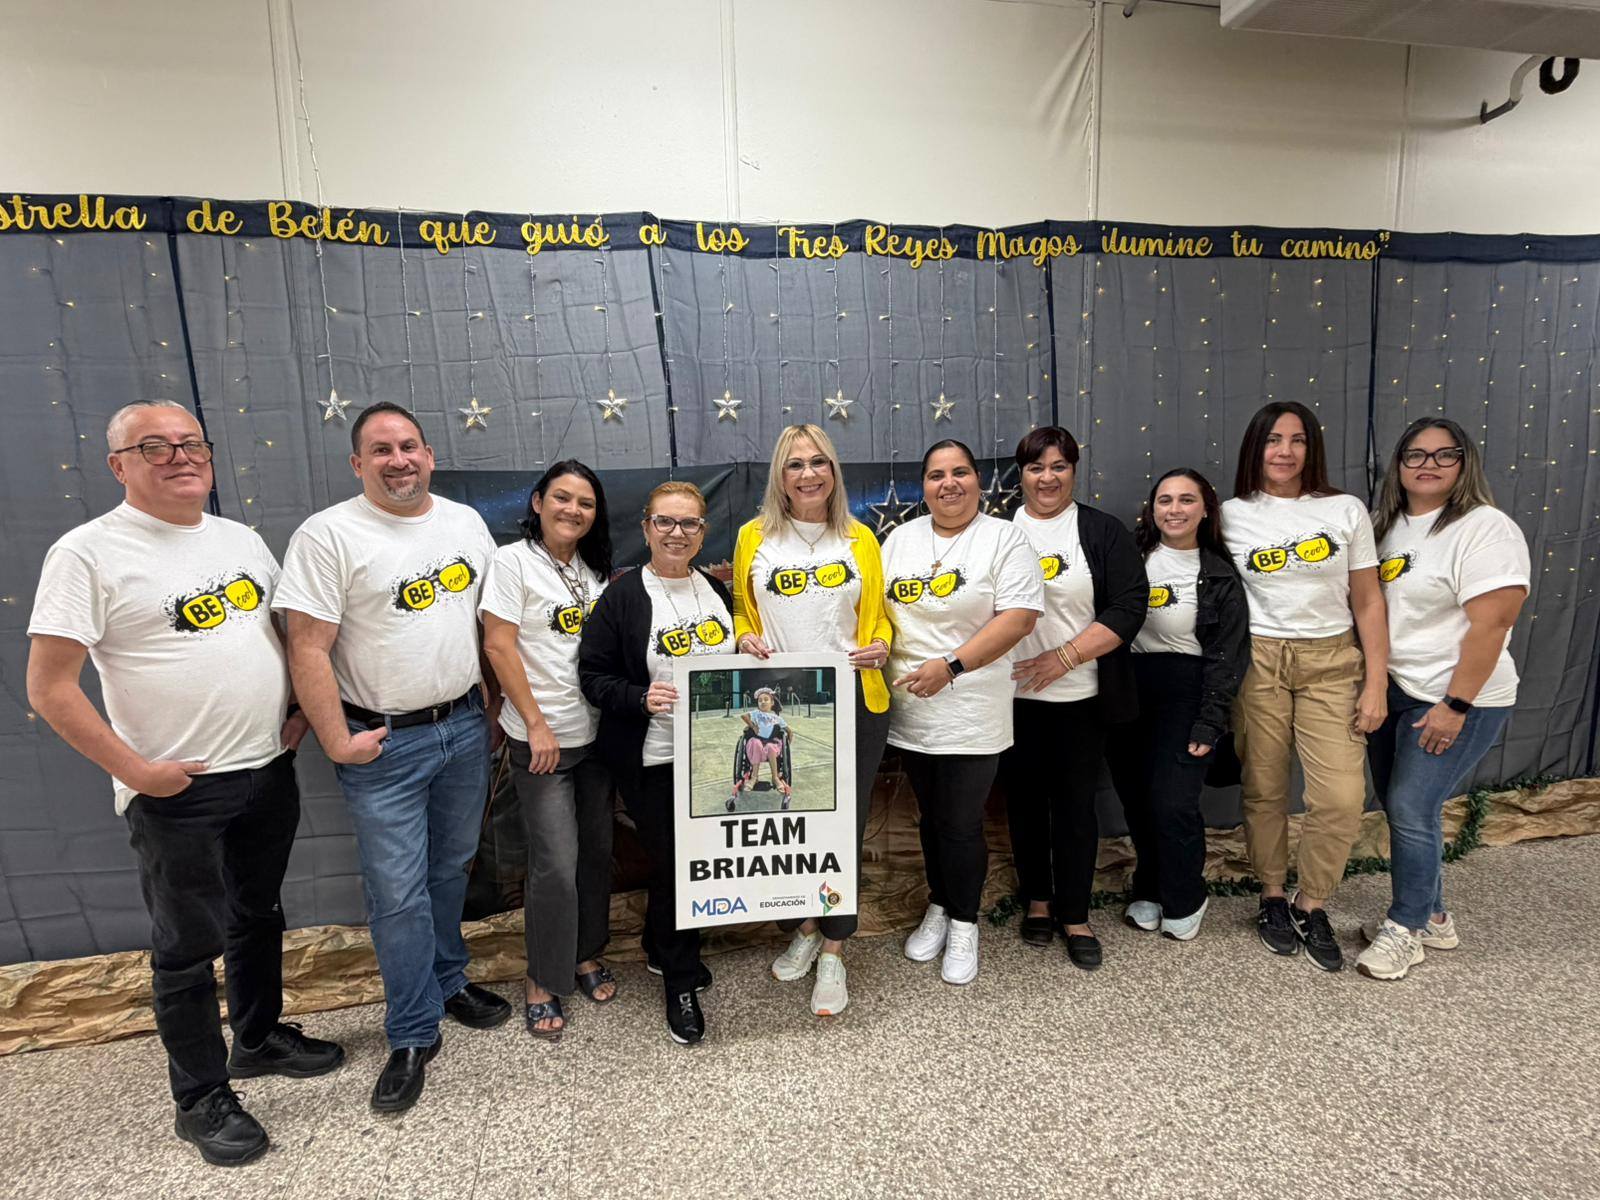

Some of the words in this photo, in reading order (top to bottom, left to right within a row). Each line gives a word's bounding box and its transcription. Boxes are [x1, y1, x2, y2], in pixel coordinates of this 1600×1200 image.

[186, 200, 244, 235] de
[268, 201, 390, 246] Belén
[418, 217, 497, 254] que
[520, 216, 610, 256] guió
[638, 220, 666, 246] a
[695, 221, 750, 252] los
[777, 225, 849, 259] Tres
[864, 224, 958, 269] Reyes
[976, 230, 1082, 267] Magos
[1101, 225, 1213, 257] ilumine
[1231, 230, 1263, 257] tu
[1257, 550, 1283, 568] BE
[780, 572, 803, 590] BE
[898, 582, 919, 598] BE
[407, 582, 433, 606] BE
[188, 597, 223, 625] BE
[562, 609, 580, 630] BE
[666, 632, 689, 652] BE
[720, 816, 806, 849] TEAM
[689, 852, 842, 882] BRIANNA
[691, 896, 748, 918] MDA
[759, 898, 806, 909] EDUCACIÓN
